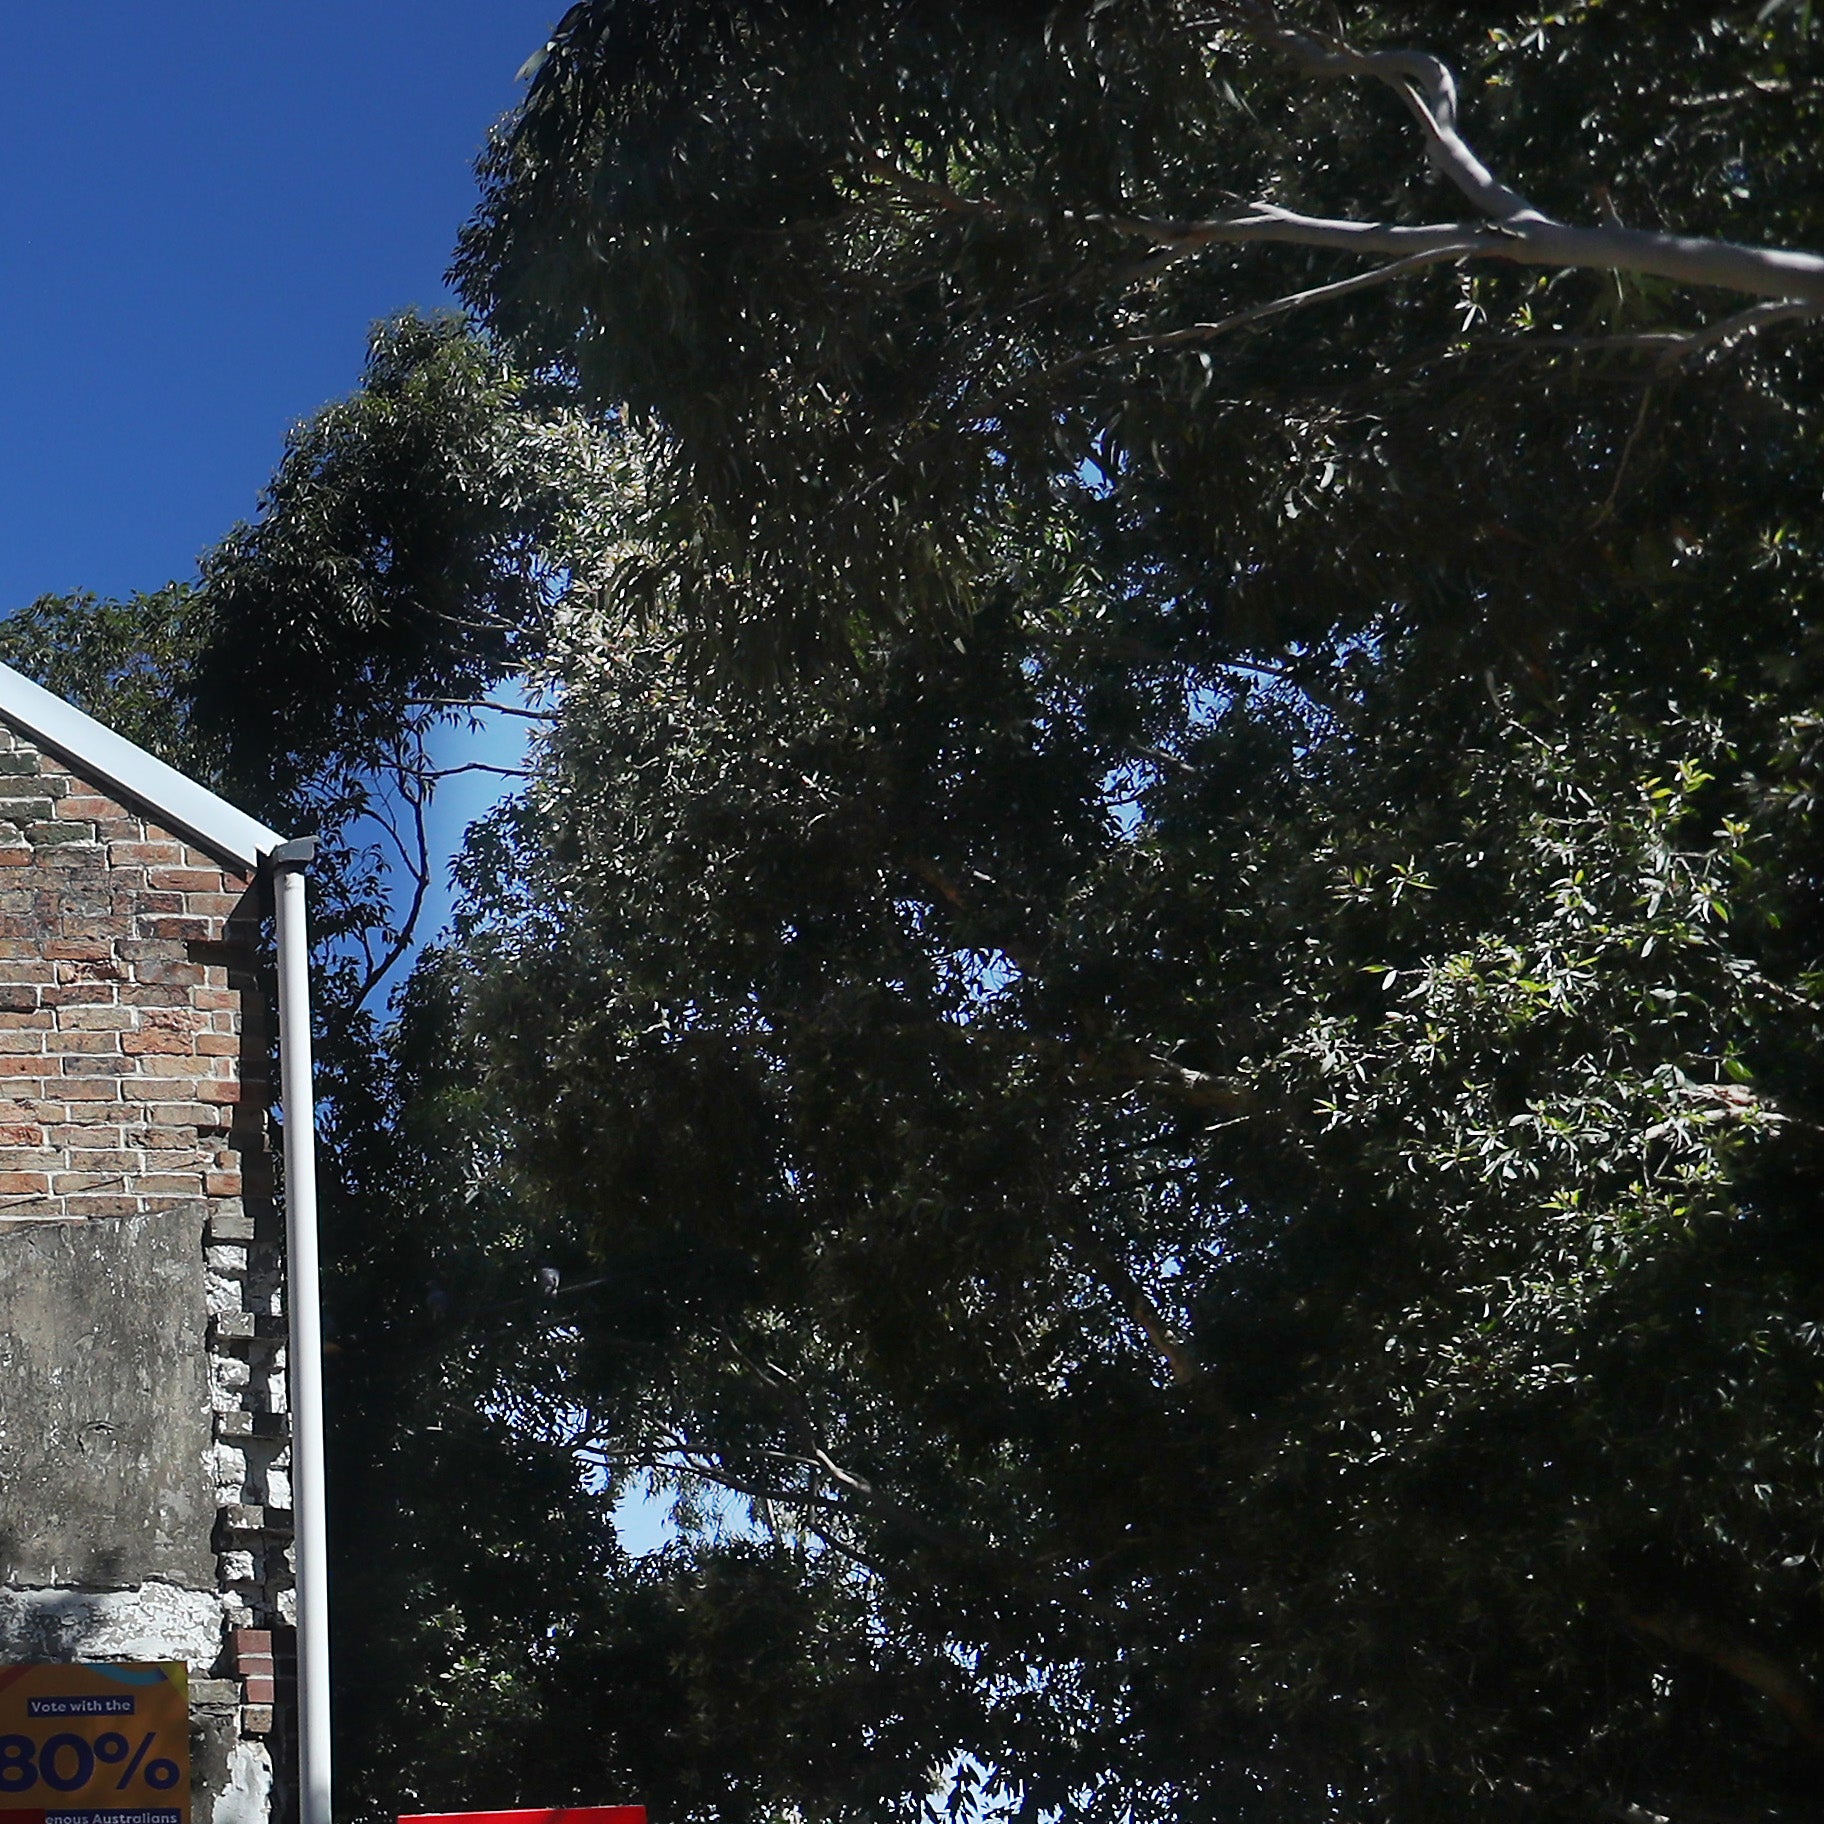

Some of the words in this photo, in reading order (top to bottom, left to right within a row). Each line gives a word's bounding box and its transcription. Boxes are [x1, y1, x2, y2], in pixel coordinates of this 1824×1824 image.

[31, 1701, 67, 1713] Vote
[69, 1700, 103, 1712] with
[105, 1699, 131, 1711] the
[92, 1812, 178, 1824] Australians
